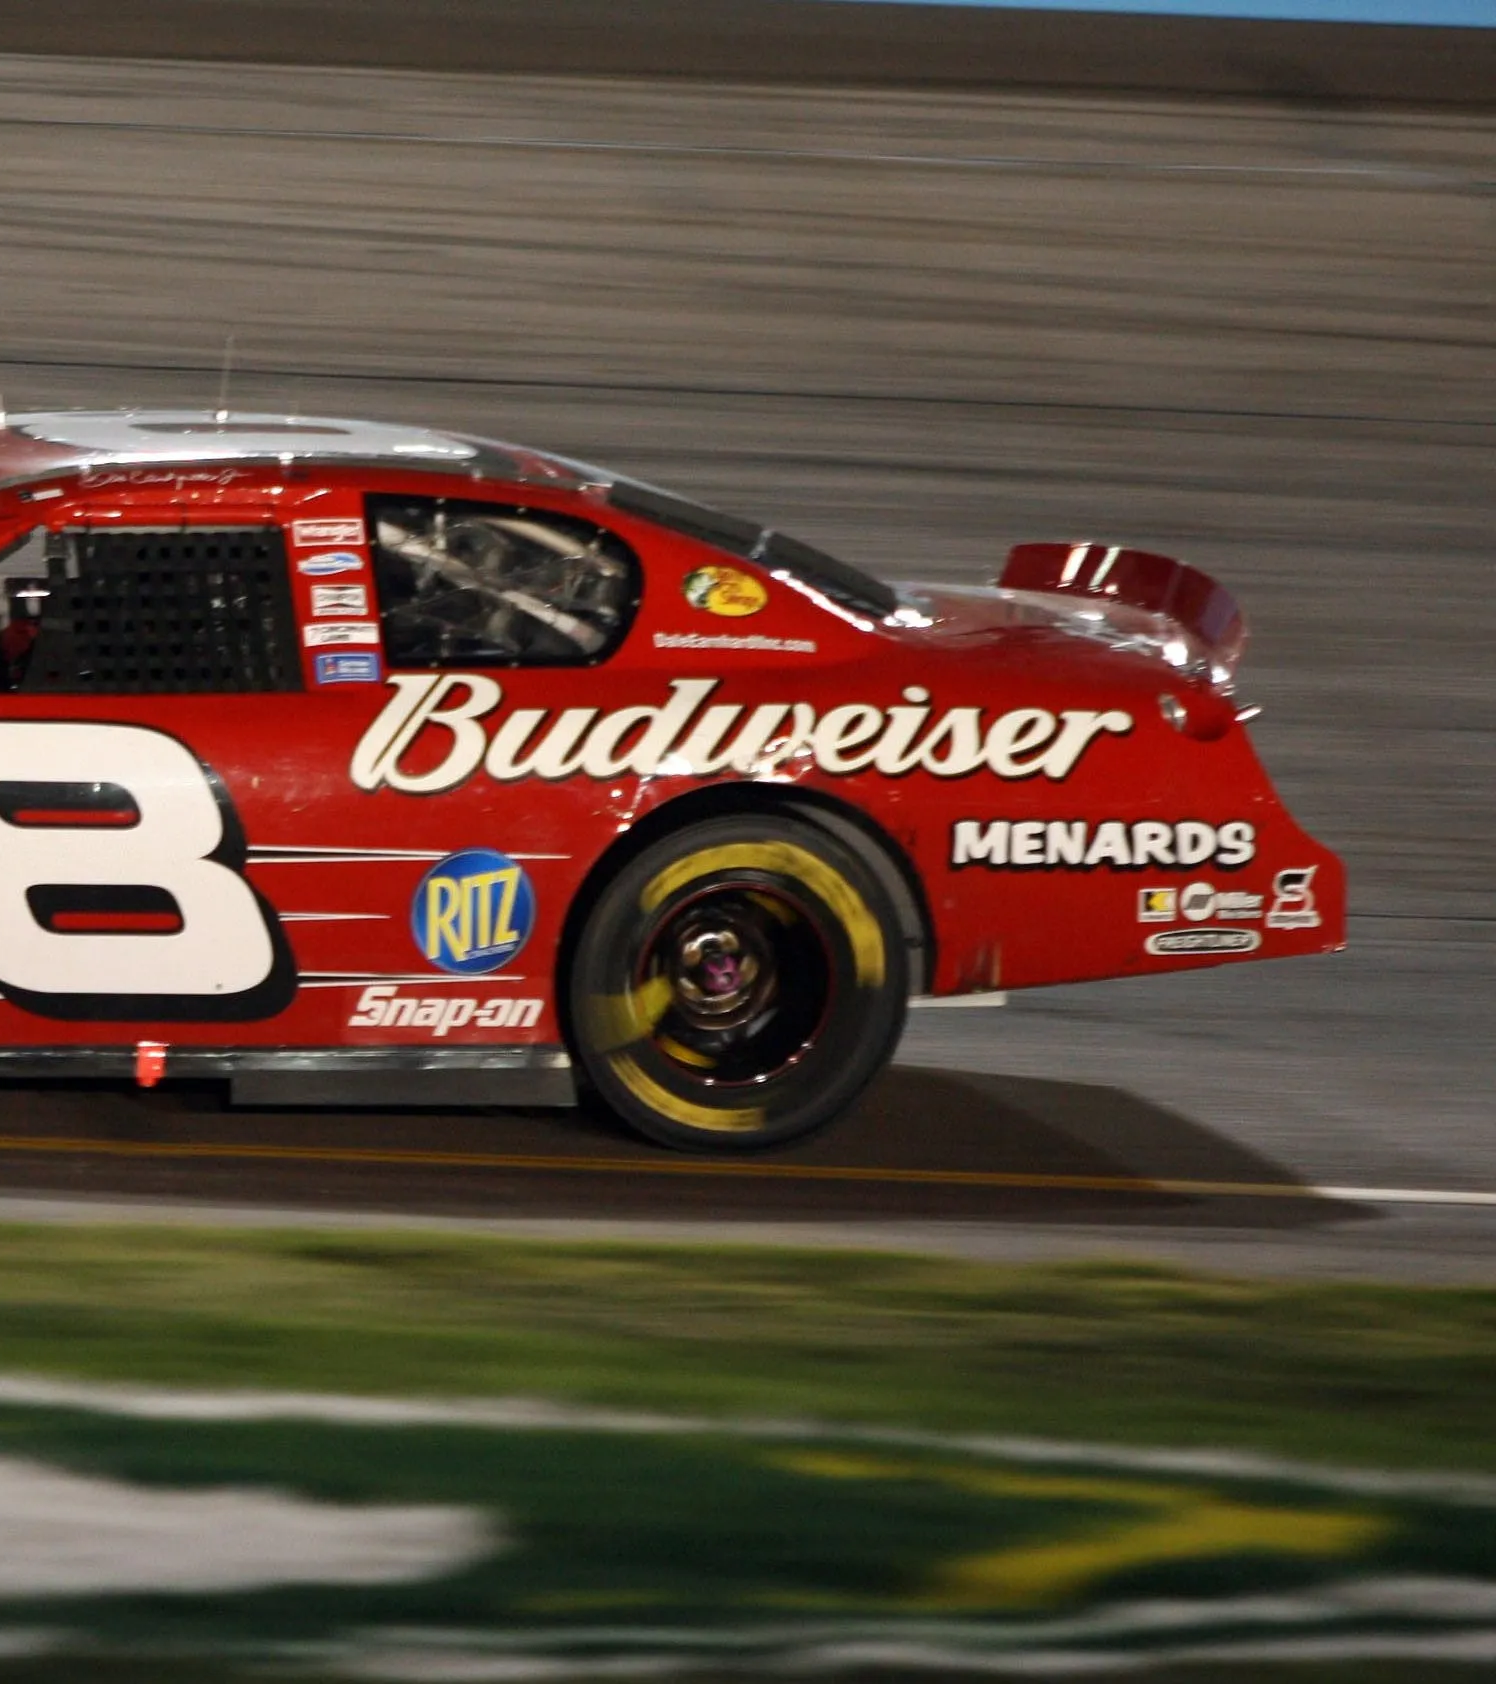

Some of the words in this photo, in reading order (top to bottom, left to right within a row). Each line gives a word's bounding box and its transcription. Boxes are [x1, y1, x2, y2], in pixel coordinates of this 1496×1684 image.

[348, 673, 1134, 795] Budweiser
[952, 820, 1256, 868] MENARDS
[426, 866, 522, 963] RITZ
[348, 986, 545, 1037] Snap-on
